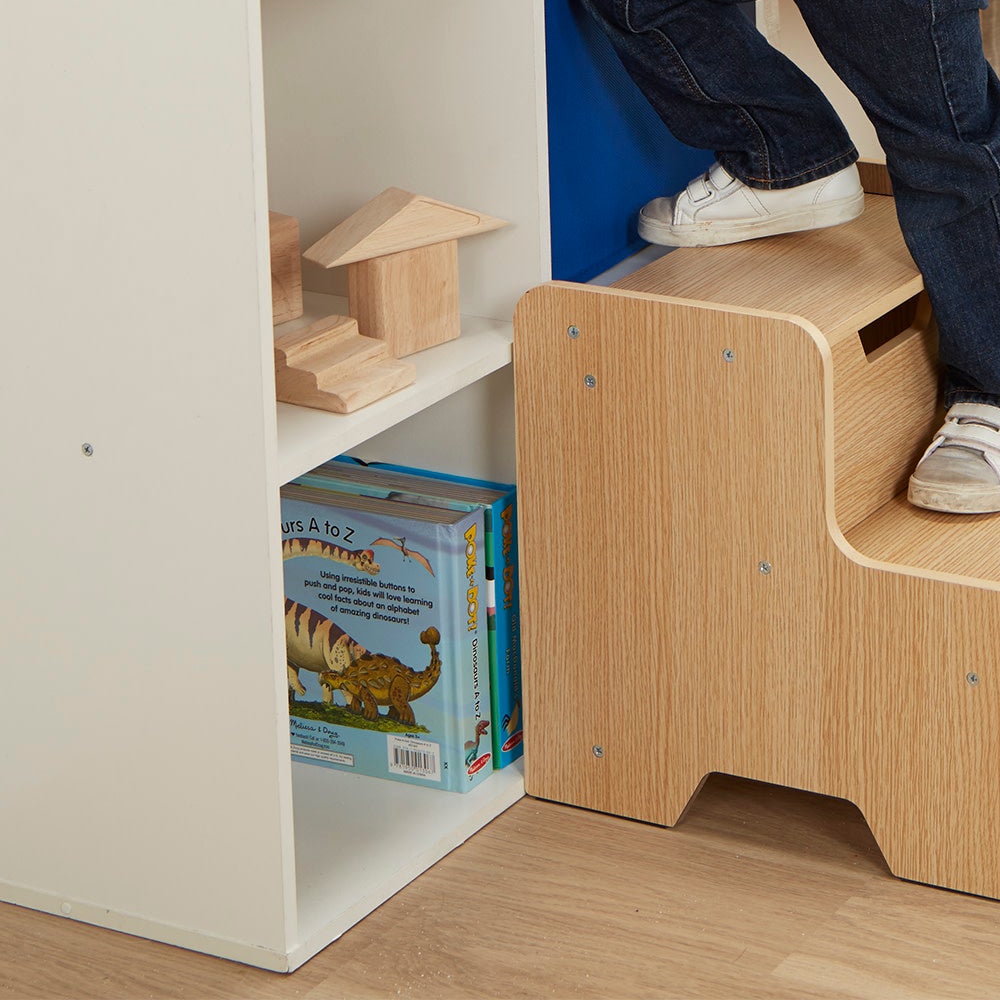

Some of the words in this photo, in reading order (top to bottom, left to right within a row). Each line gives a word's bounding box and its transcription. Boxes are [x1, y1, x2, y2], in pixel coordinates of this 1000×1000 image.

[308, 517, 320, 533] A
[324, 520, 340, 537] to
[343, 526, 355, 544] Z
[320, 570, 340, 582] Using
[342, 574, 377, 587] irresistible
[379, 580, 406, 592] buttons
[408, 585, 415, 593] to
[304, 580, 321, 588] push
[339, 586, 354, 595] pop,
[356, 587, 370, 597] kids
[372, 591, 384, 599] will
[386, 592, 401, 602] love
[403, 595, 433, 609] learning
[318, 593, 333, 601] cool
[334, 594, 351, 604] facts
[353, 598, 374, 608] about
[387, 604, 419, 616] alphabet
[330, 604, 338, 612] of
[340, 607, 370, 620] amazing
[372, 612, 410, 625] dinosaurs!
